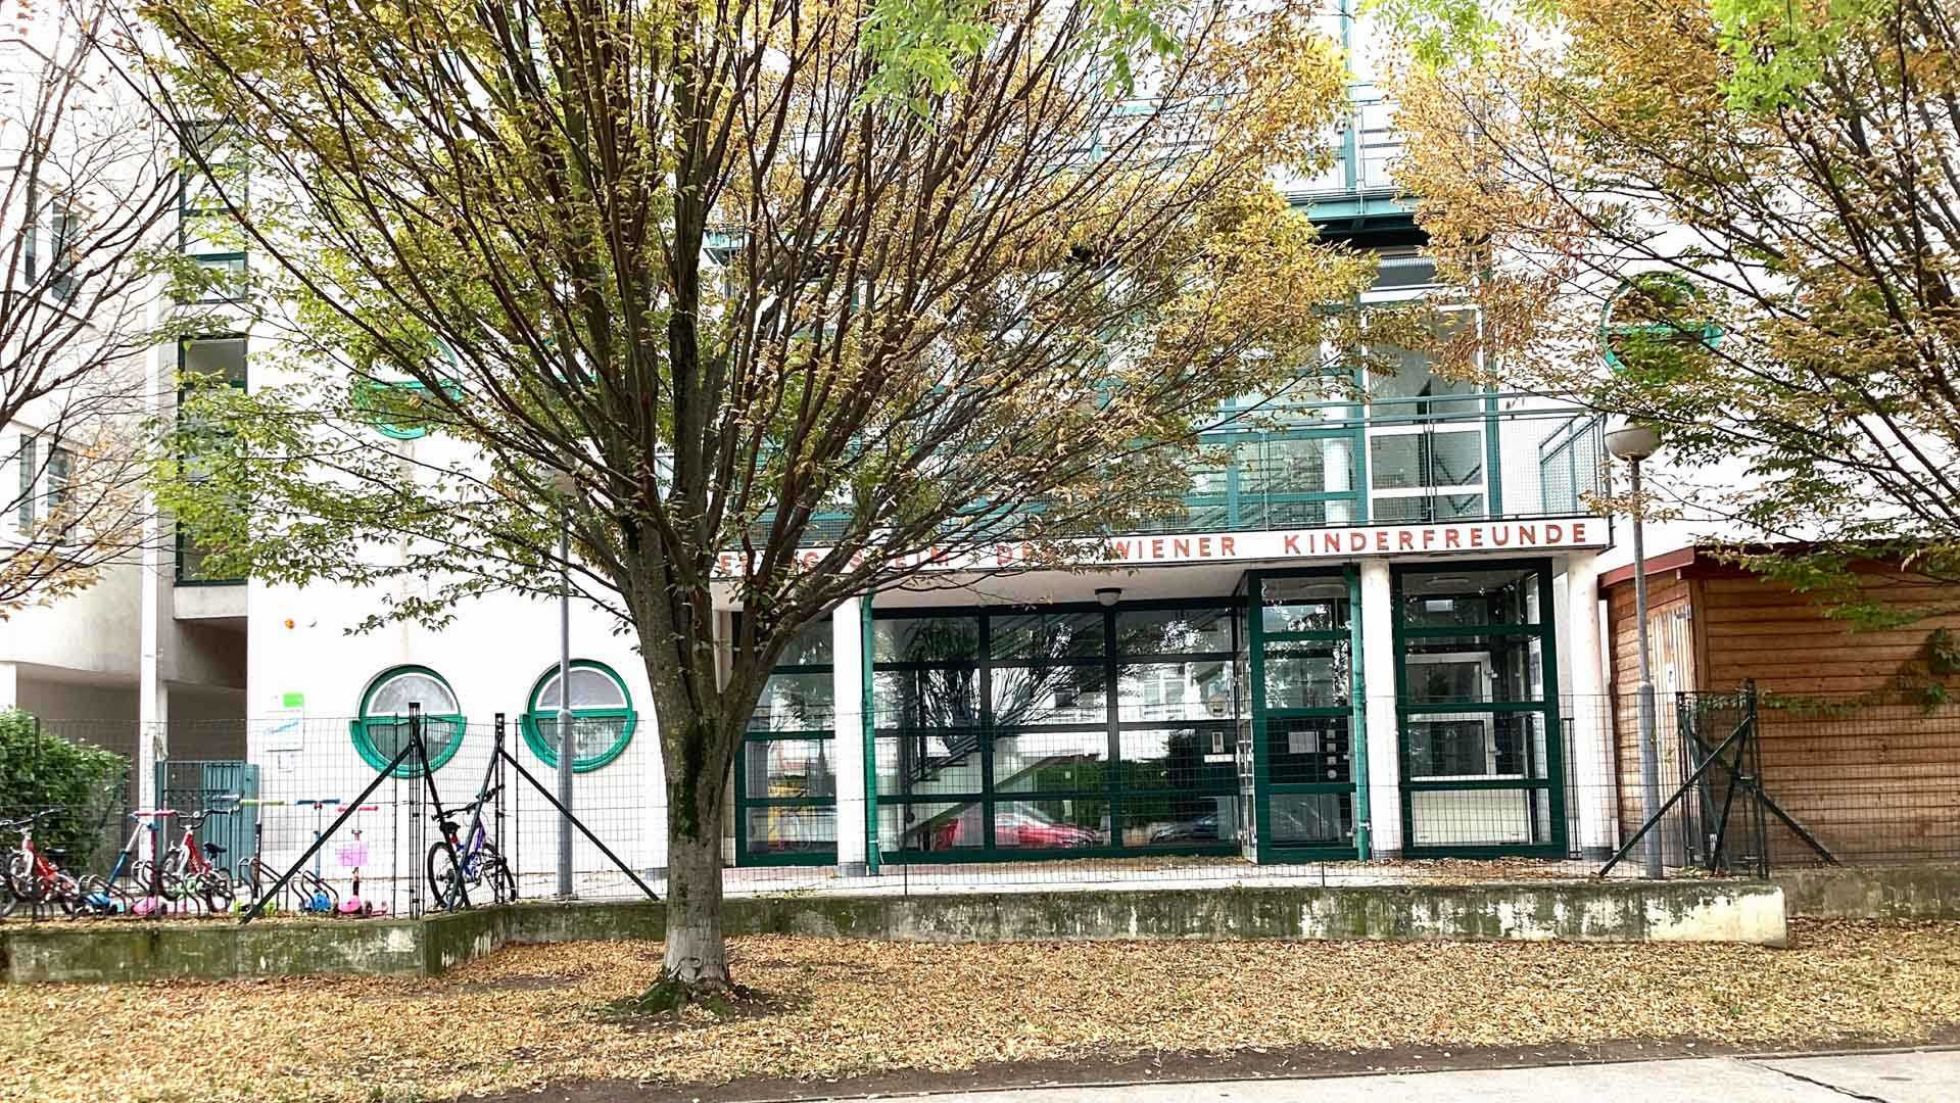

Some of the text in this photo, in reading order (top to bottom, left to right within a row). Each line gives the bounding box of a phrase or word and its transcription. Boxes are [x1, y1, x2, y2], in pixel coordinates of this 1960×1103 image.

[996, 540, 1061, 565] DE
[1105, 536, 1236, 560] WIENER
[1284, 523, 1586, 554] KINDERFREUNDE
